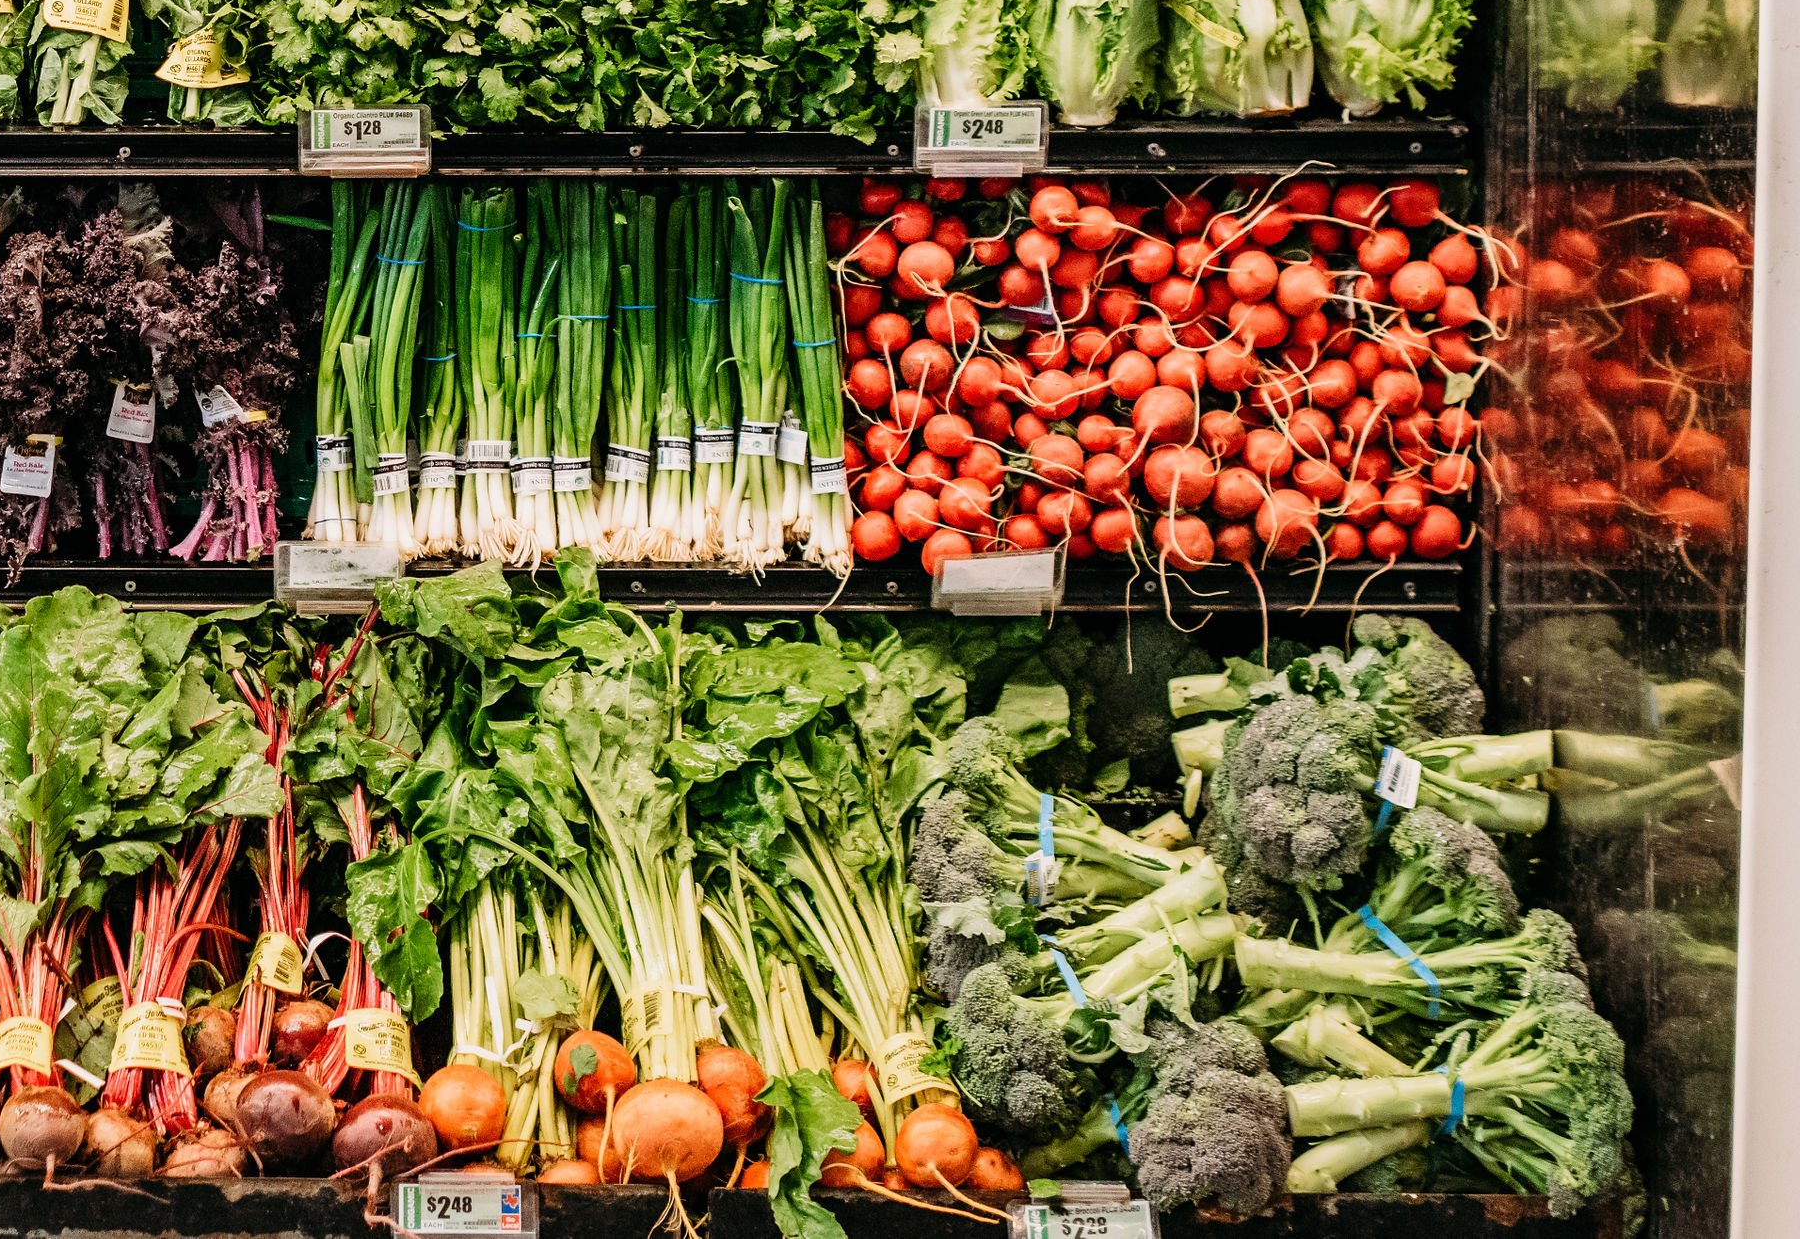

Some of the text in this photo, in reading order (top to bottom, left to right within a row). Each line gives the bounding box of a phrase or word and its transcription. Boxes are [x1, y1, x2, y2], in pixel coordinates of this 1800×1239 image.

[76, 6, 99, 17] 94614
[332, 112, 355, 120] Organic
[356, 111, 378, 119] Cilantro
[379, 111, 394, 119] PLU#
[317, 112, 326, 149] ORGANIC
[344, 119, 382, 141] $128
[936, 110, 946, 147] ORGANIC
[962, 119, 1004, 140] $248
[120, 406, 136, 415] Red
[11, 461, 45, 470] Red Kale
[407, 1187, 416, 1228] ORGANIC
[426, 1195, 473, 1220] $248
[504, 1215, 516, 1223] Go
